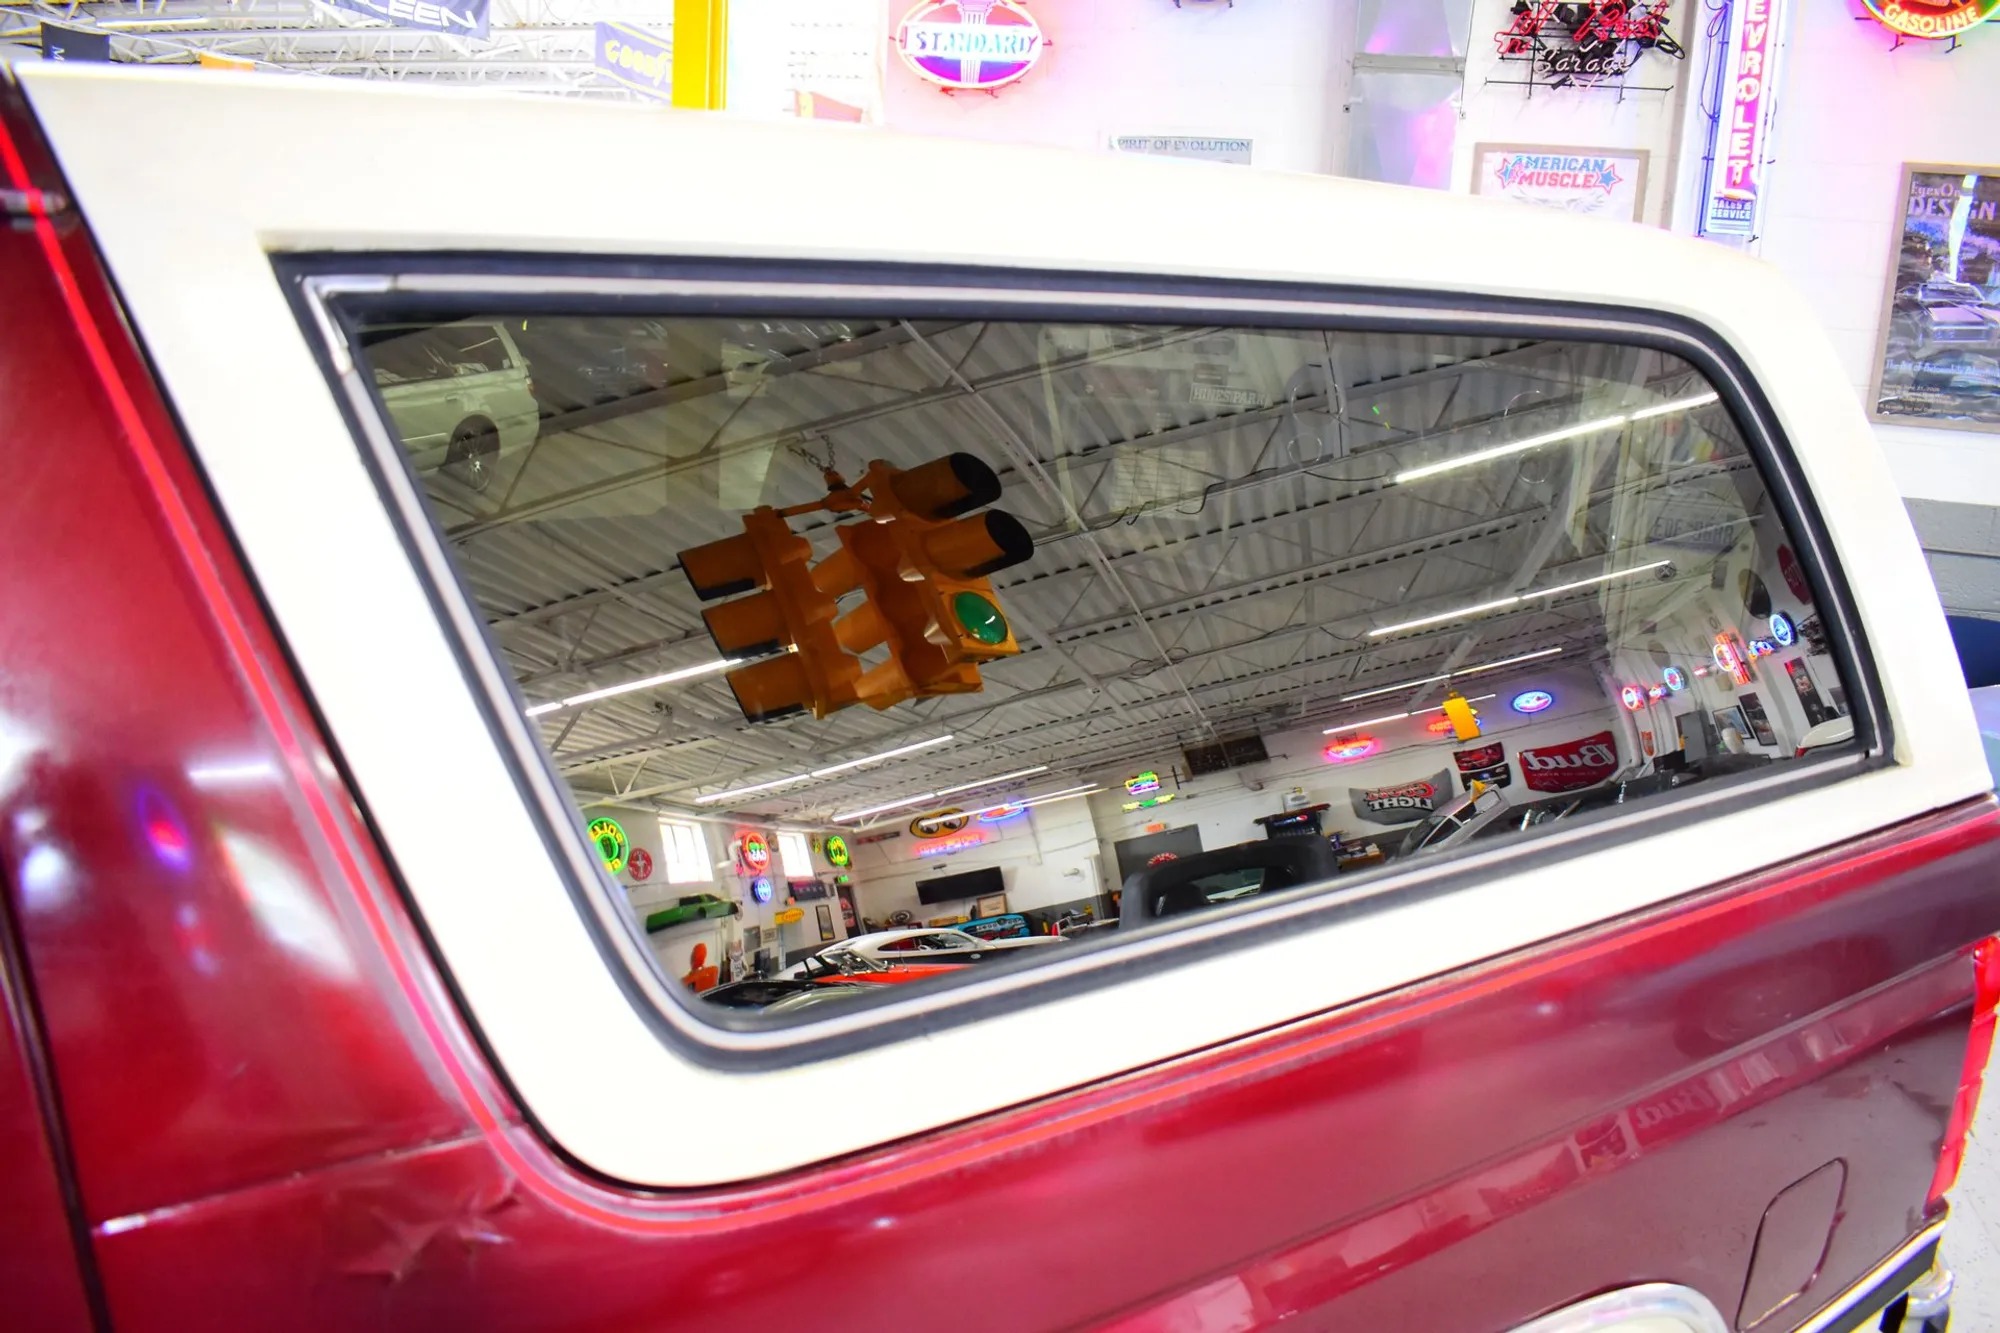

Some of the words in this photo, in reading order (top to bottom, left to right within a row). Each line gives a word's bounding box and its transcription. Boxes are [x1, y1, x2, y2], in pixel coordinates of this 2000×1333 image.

[1884, 4, 1980, 33] GASOLINE
[914, 30, 1038, 55] STANDARD
[1533, 48, 1631, 78] Garage
[1114, 138, 1149, 150] PIRIT
[1153, 139, 1171, 150] OF
[1174, 140, 1250, 152] EVOLUTION
[1511, 155, 1607, 172] AMERICAN
[1517, 171, 1597, 188] MUSCLE
[1711, 208, 1752, 219] SERVICE
[1907, 196, 1997, 221] DESGN
